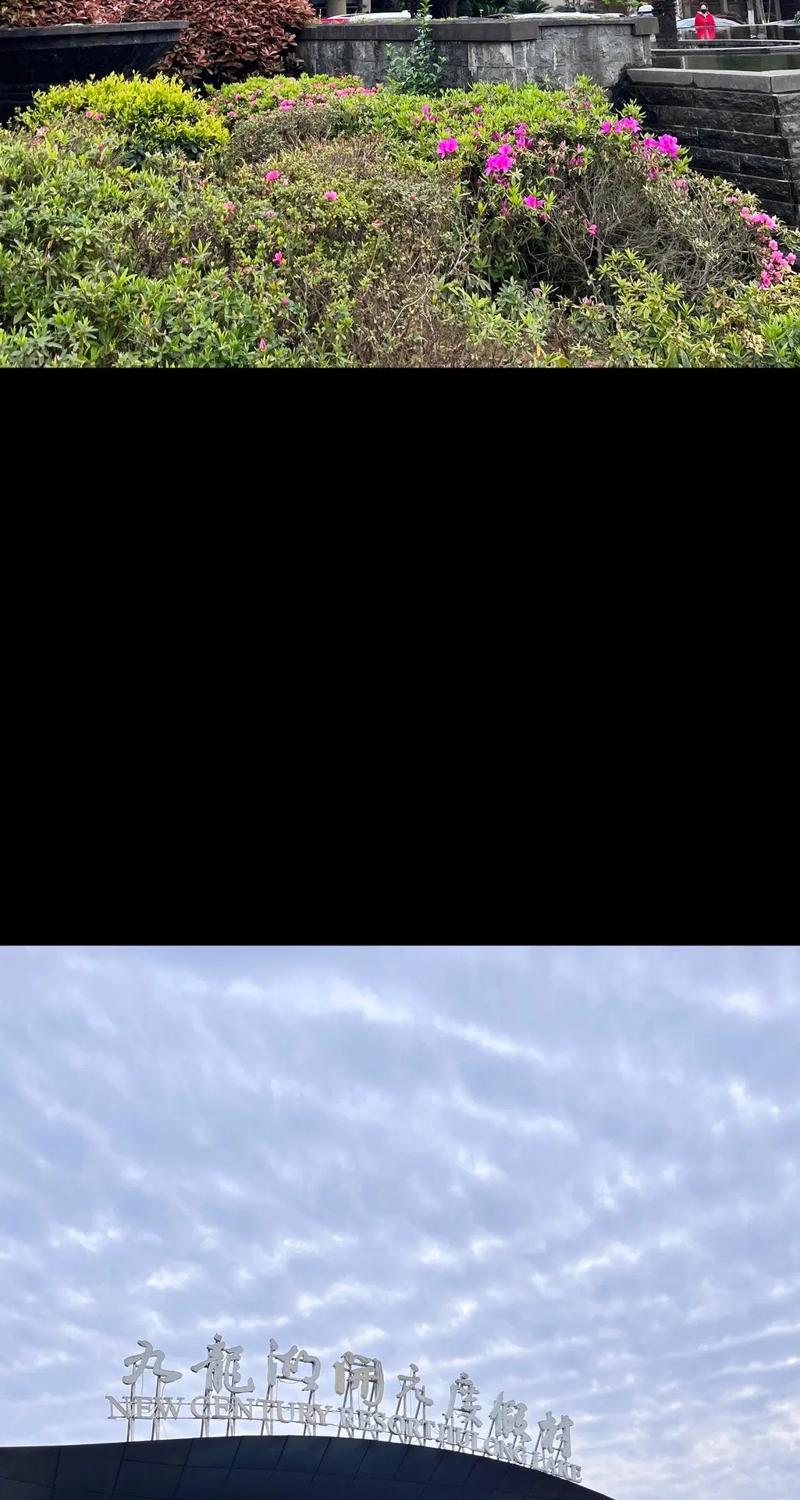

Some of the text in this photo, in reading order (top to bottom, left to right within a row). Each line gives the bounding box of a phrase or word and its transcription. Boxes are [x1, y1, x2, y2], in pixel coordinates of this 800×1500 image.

[105, 1396, 185, 1420] NEW
[191, 1396, 333, 1426] CENTURY
[338, 1408, 436, 1441] RESORT
